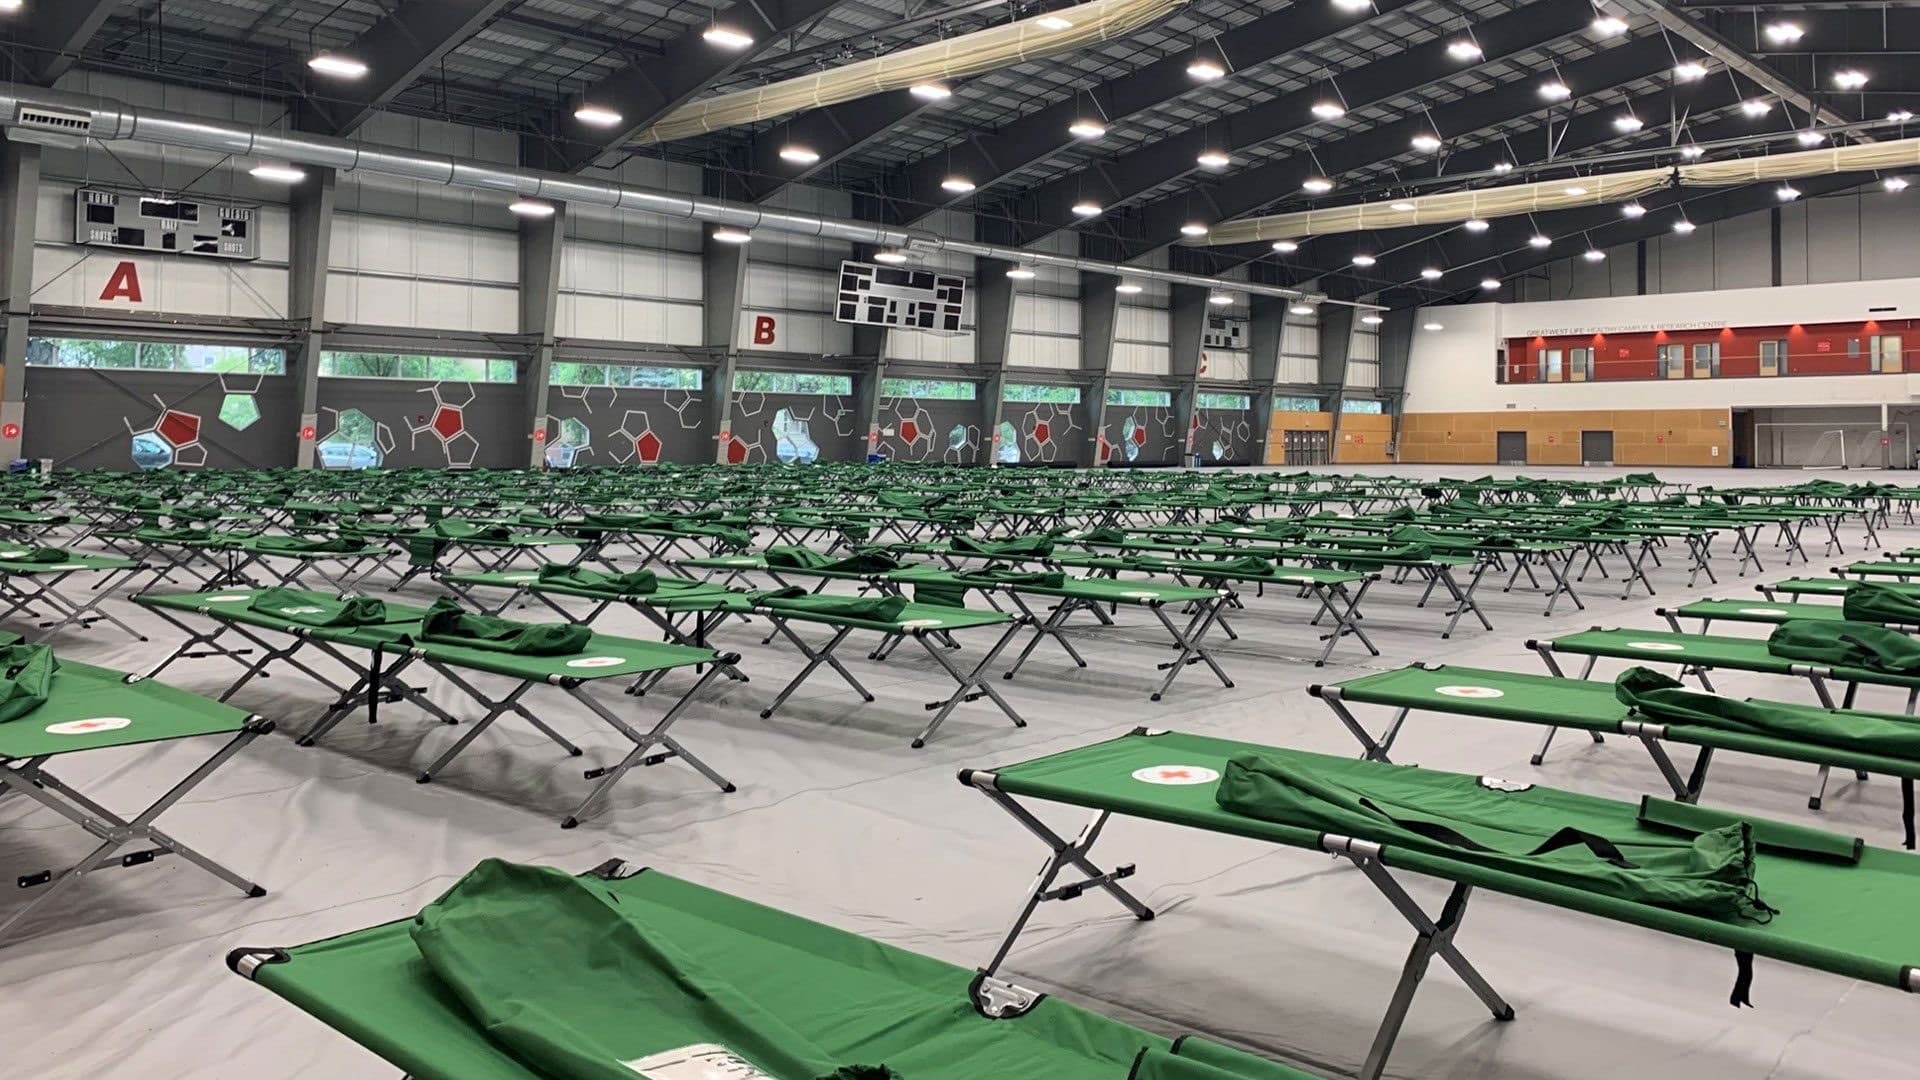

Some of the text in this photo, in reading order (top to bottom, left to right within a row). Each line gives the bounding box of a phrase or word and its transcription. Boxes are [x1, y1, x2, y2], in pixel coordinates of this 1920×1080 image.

[88, 192, 113, 205] HOME
[219, 207, 249, 220] GUESTS
[99, 261, 143, 302] A
[753, 315, 776, 345] B
